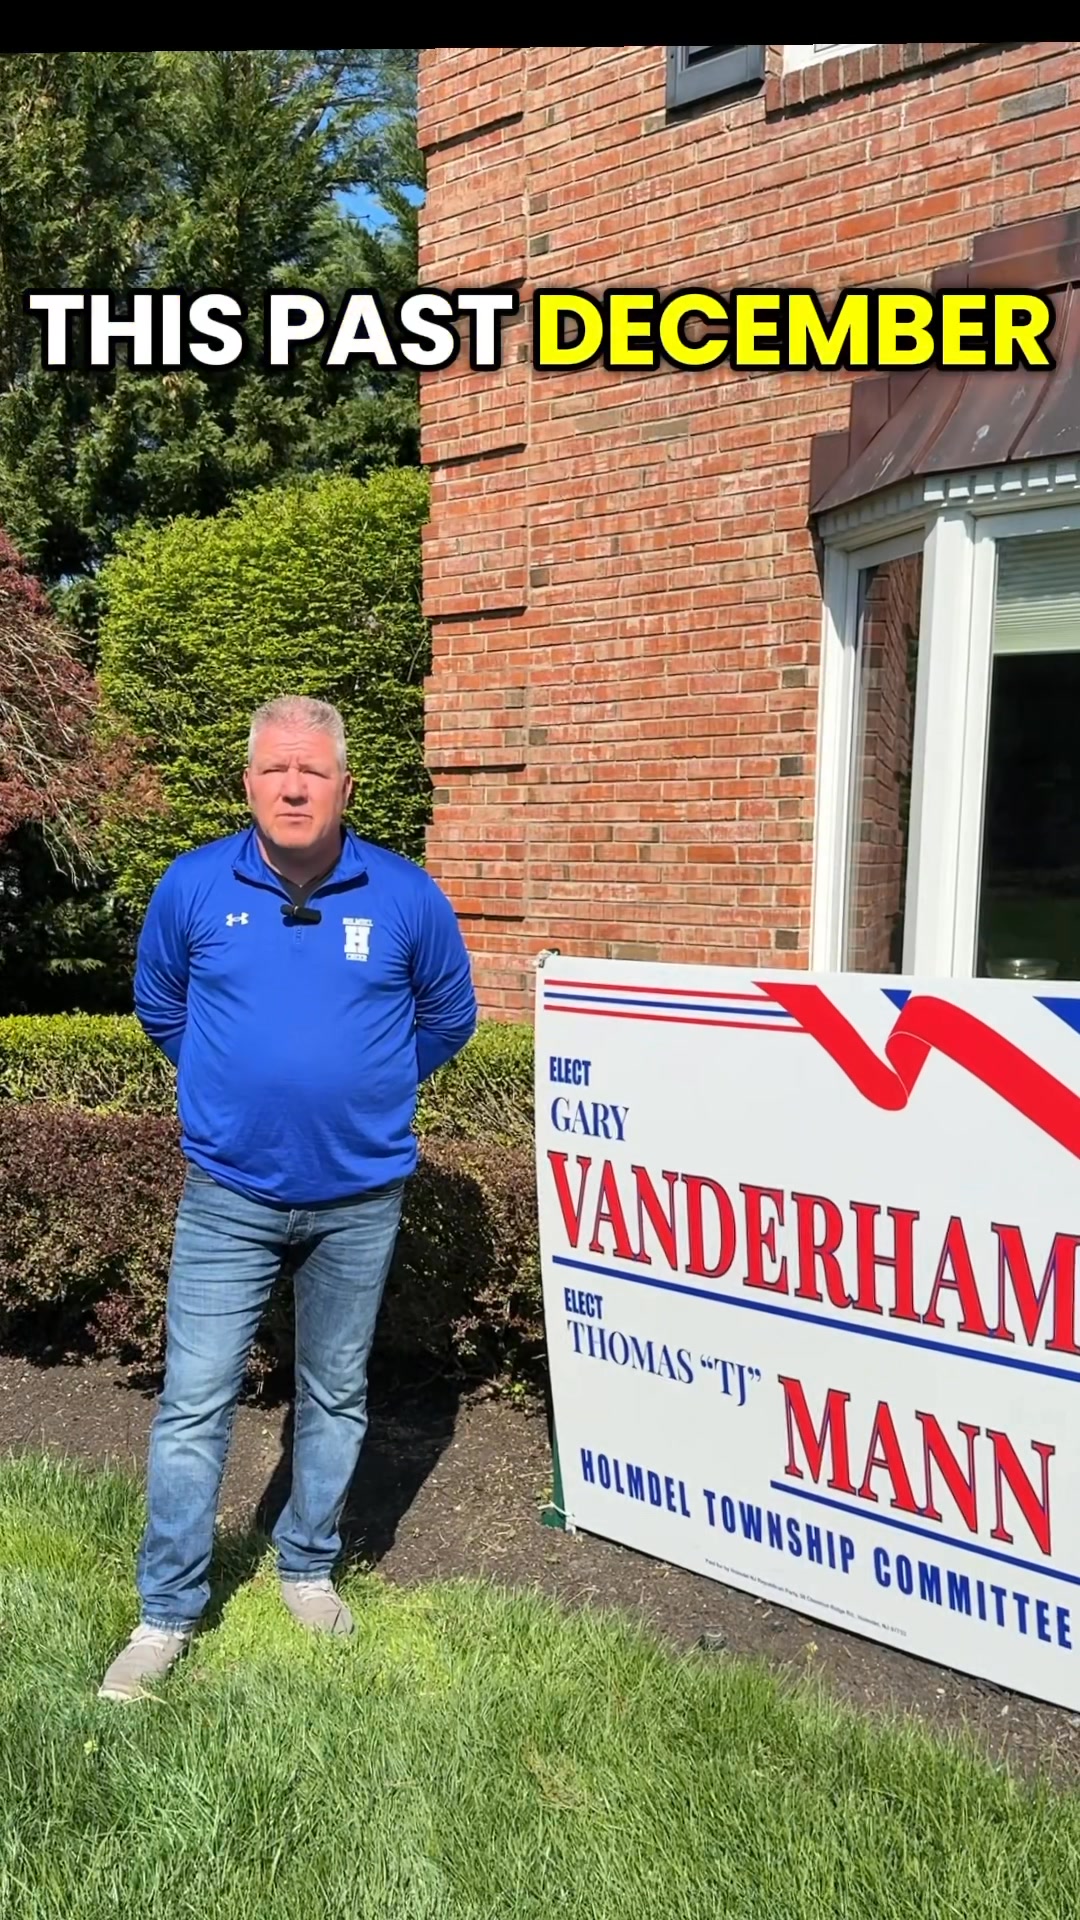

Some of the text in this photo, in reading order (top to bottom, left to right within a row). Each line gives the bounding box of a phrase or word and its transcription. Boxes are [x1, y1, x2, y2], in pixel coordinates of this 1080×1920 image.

[344, 925, 370, 954] H
[549, 1055, 592, 1087] ELECT
[551, 1096, 629, 1142] GARY
[546, 1149, 1080, 1357] VANDERHAM
[564, 1287, 603, 1320] ELECT
[567, 1319, 762, 1407] THOMAS “TJ”
[777, 1374, 1056, 1557] MANN
[580, 1447, 1072, 1650] HOLMDEL TOWNSHIP COMMITTEE
